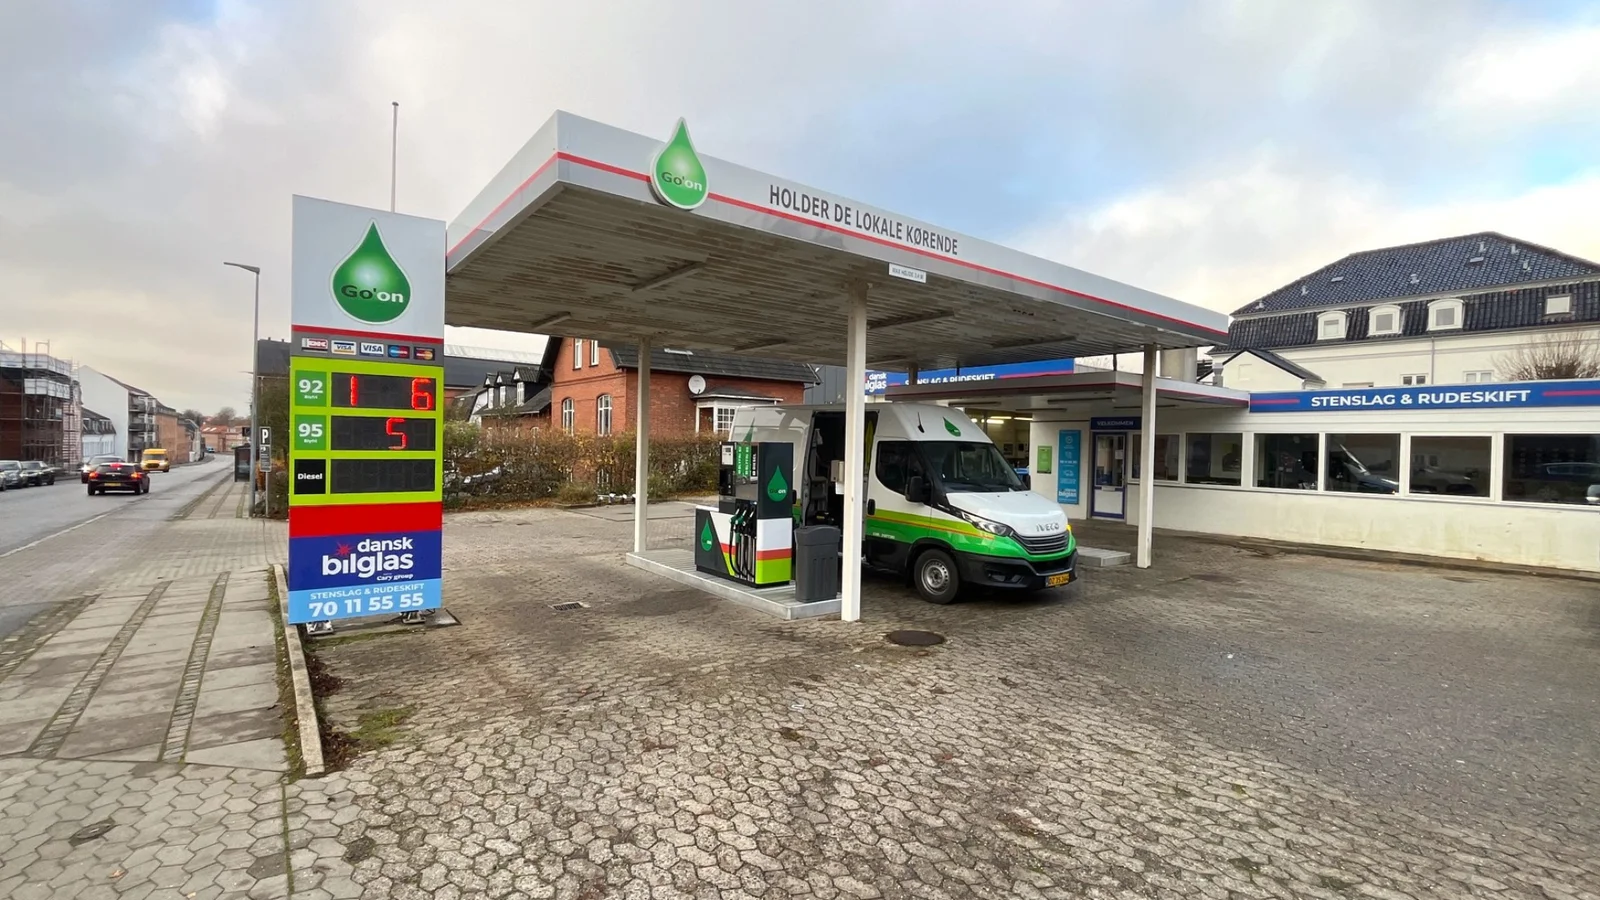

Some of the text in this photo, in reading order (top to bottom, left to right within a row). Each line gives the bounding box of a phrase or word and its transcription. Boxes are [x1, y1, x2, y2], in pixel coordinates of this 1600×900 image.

[661, 171, 702, 191] Go'on
[770, 184, 958, 255] HOLDER DE LOKALE KØRENDE
[341, 284, 403, 303] Go'on
[363, 344, 383, 353] VISA
[869, 372, 887, 380] dansk
[298, 379, 323, 394] 92
[411, 377, 433, 411] 6
[1311, 390, 1531, 407] STENSLAG & RUDESKIFT
[262, 428, 269, 444] P
[298, 423, 323, 437] 95
[385, 417, 407, 451] 5
[1036, 522, 1060, 532] IVECO
[357, 537, 413, 552] dansk
[322, 551, 413, 578] bilglas
[310, 588, 362, 600] STENSLAG
[373, 583, 425, 594] RUDESKIFT
[309, 593, 424, 617] 70 11 55 55
